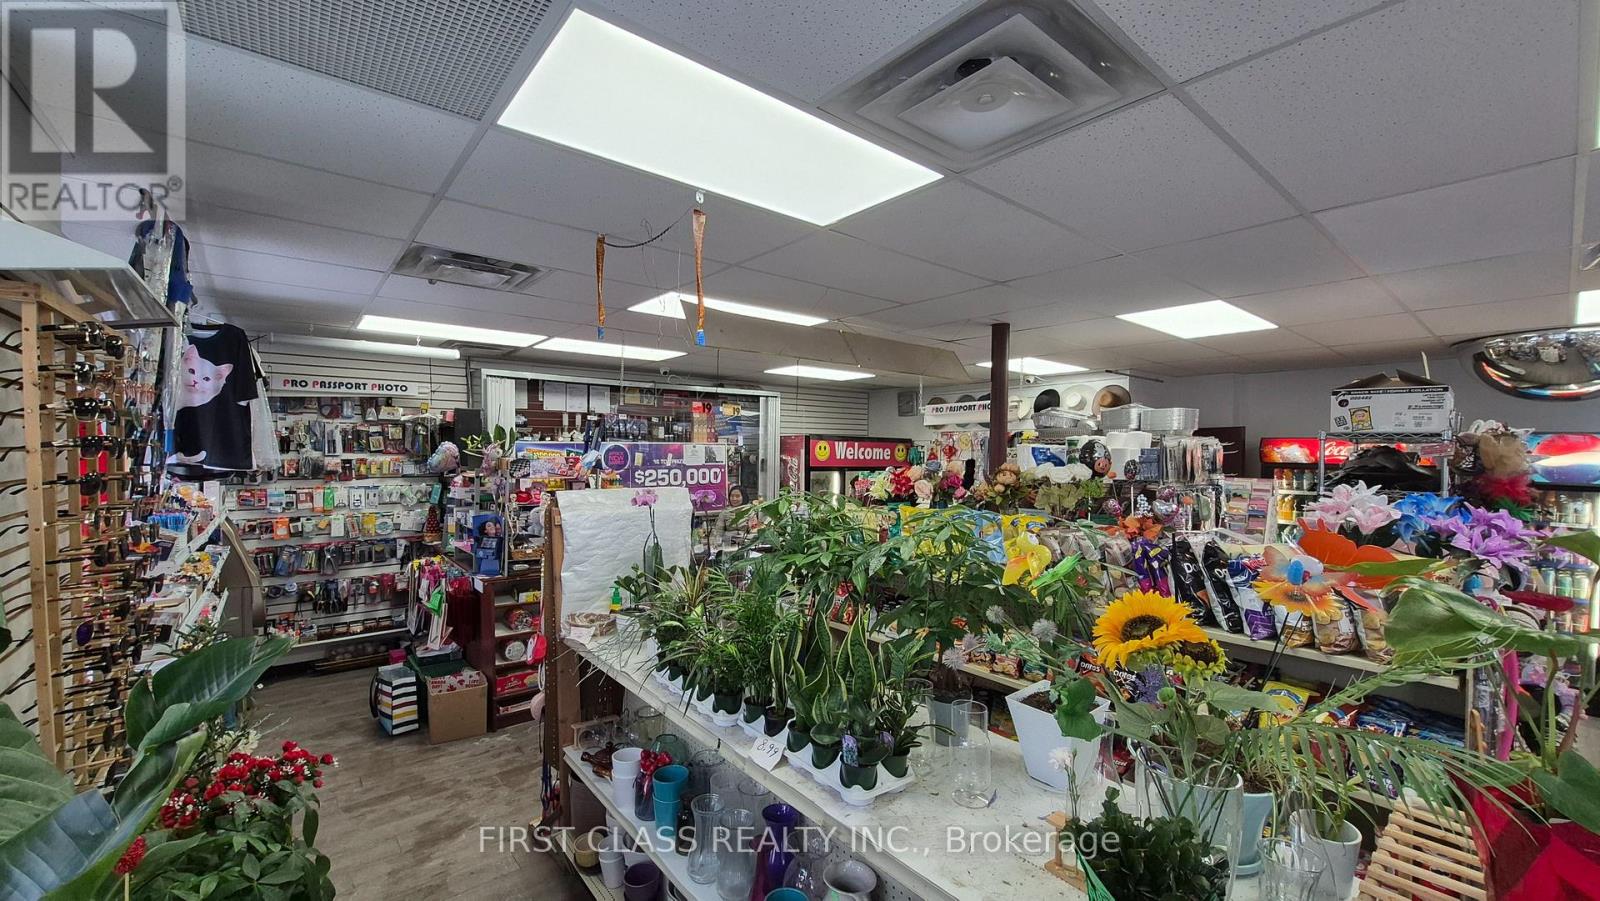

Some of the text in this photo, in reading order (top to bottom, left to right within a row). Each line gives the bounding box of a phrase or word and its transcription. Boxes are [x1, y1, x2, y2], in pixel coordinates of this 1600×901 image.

[283, 379, 408, 392] PRO PASSPORT PHOTO
[702, 403, 712, 413] 19
[732, 407, 740, 415] 19
[945, 405, 977, 413] PASSPORT
[834, 441, 891, 460] Welcome
[756, 738, 780, 758] 8.99
